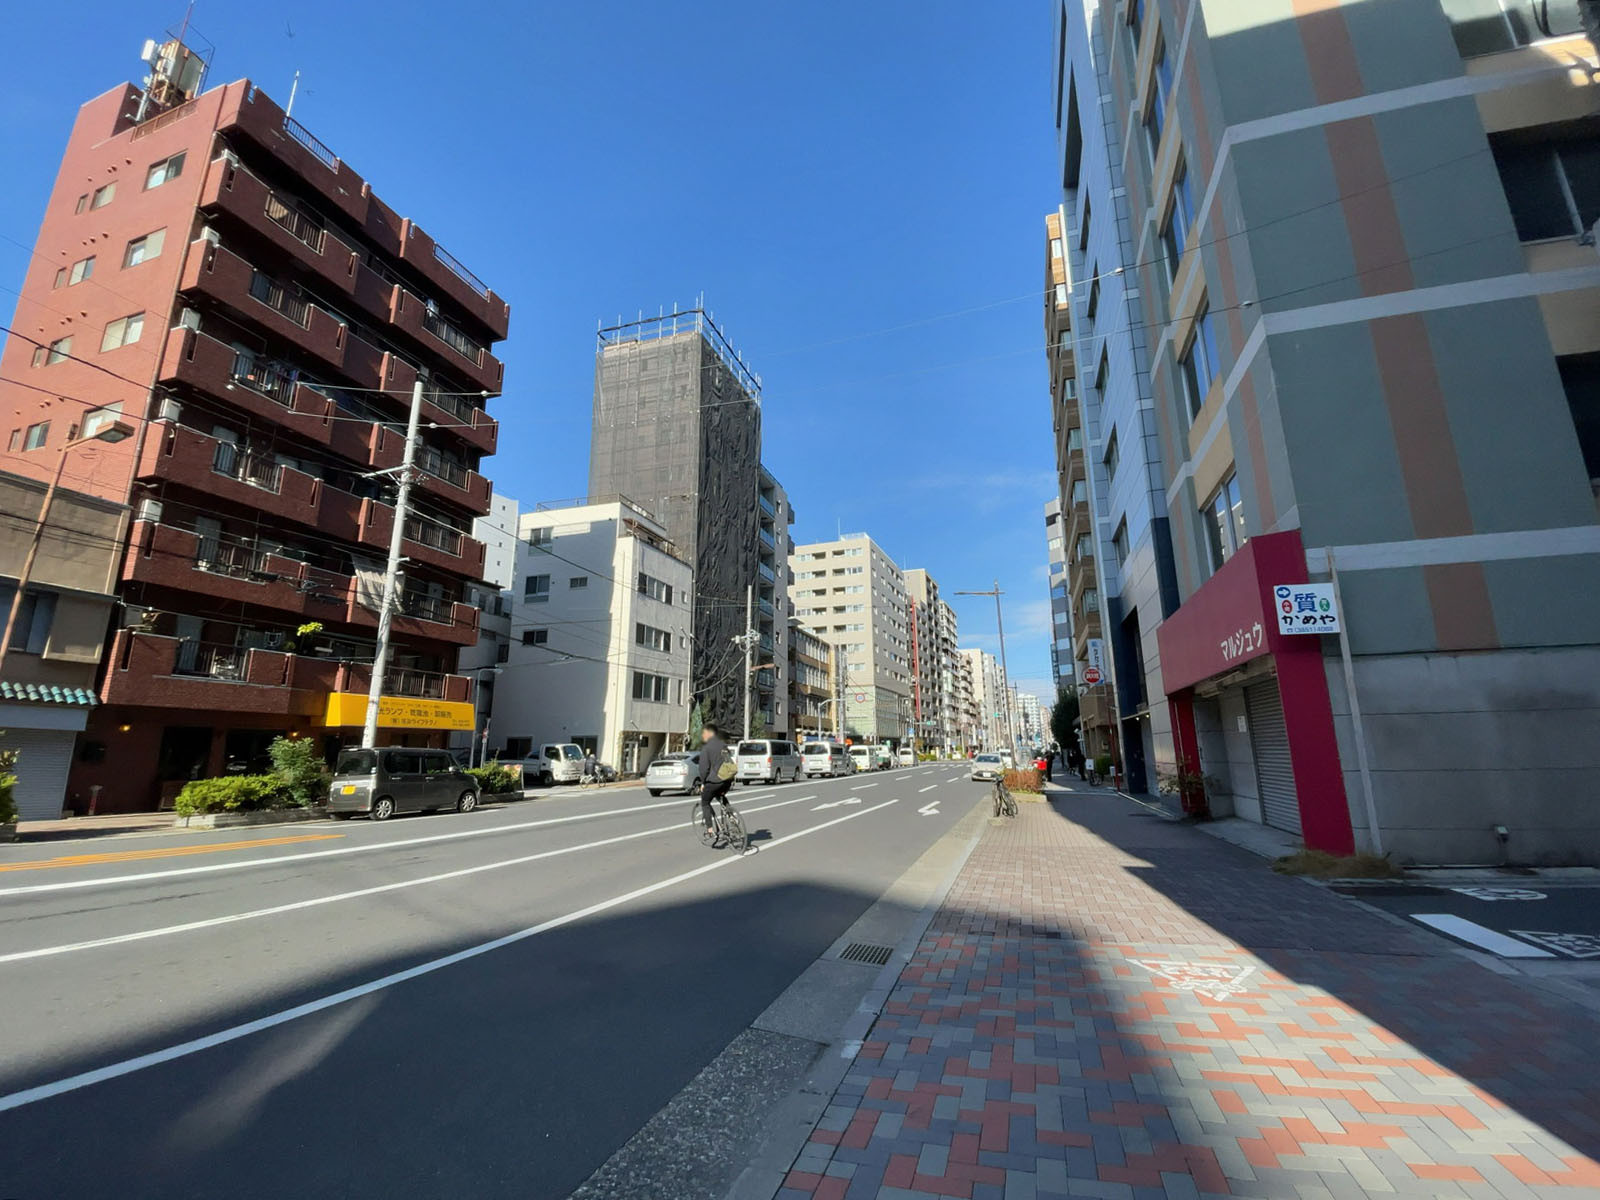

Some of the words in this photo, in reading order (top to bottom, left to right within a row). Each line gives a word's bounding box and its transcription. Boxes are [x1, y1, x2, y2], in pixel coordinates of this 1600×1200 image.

[1294, 593, 1317, 613] 質
[1282, 615, 1336, 625] かめや
[1221, 621, 1262, 661] マルジュウ
